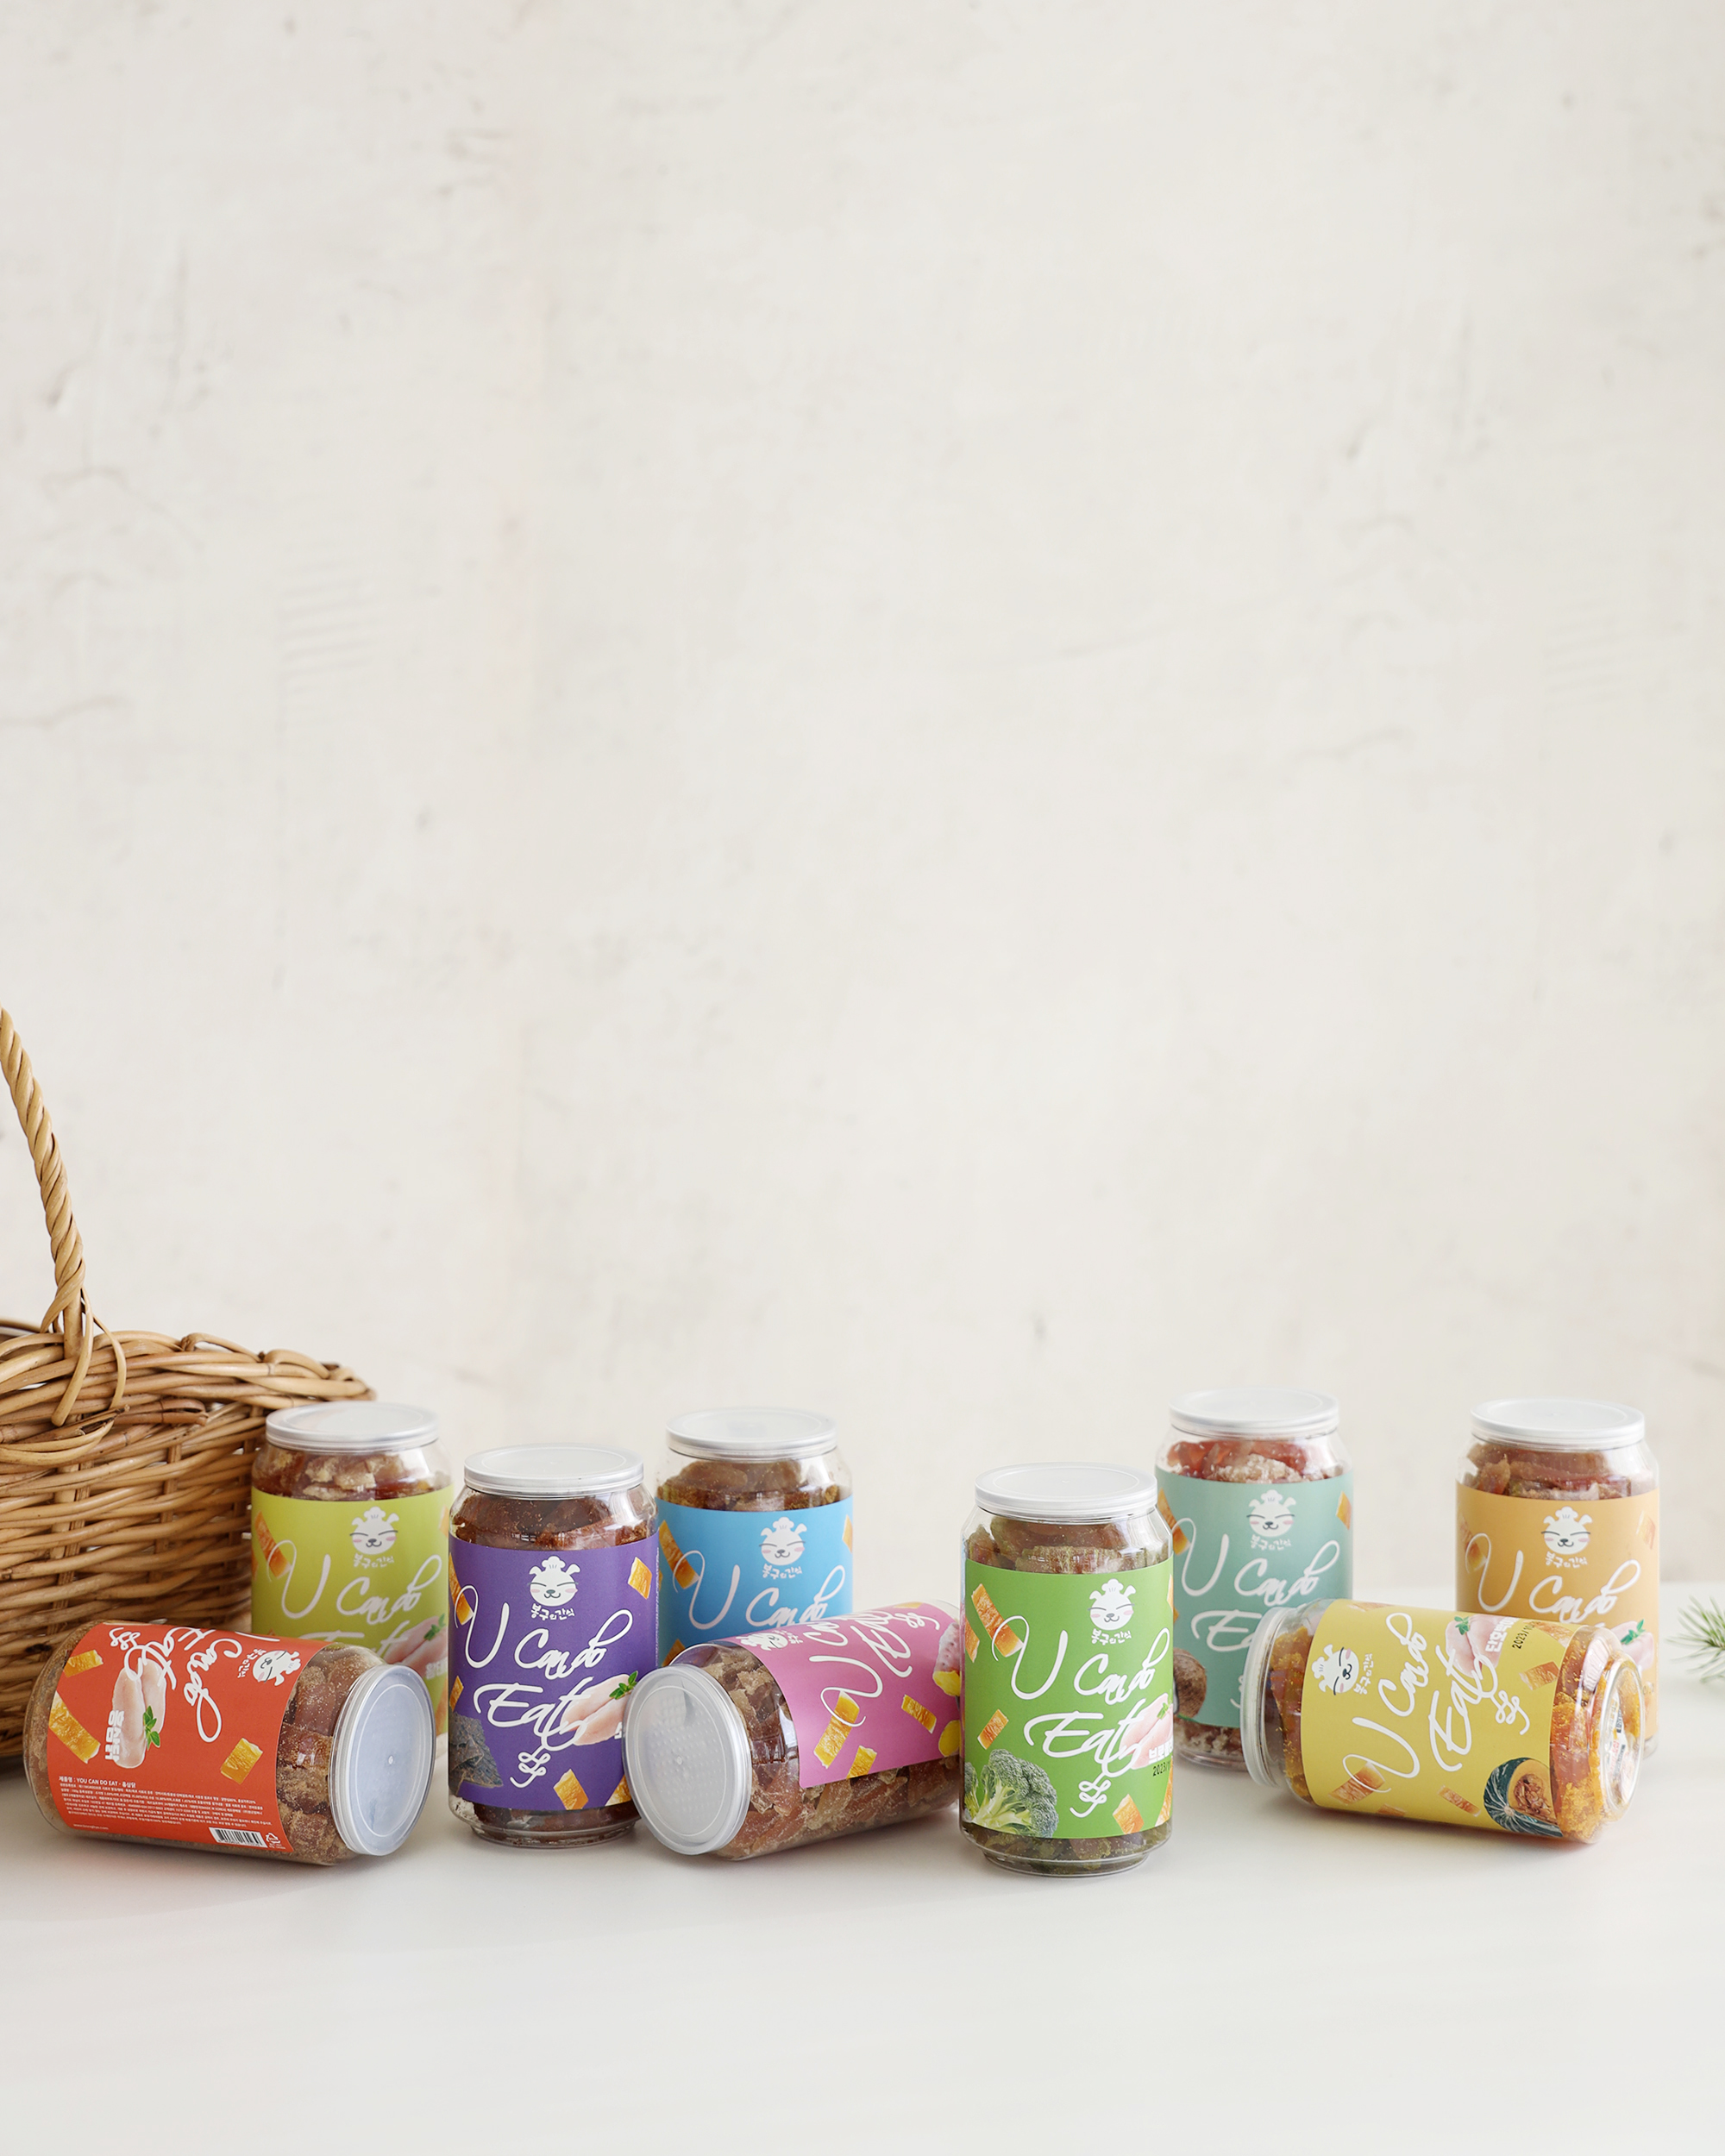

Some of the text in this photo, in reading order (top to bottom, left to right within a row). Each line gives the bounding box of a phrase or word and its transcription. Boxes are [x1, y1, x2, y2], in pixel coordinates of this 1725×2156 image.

[267, 1539, 331, 1619] U
[672, 1550, 741, 1630] U
[1465, 1532, 1524, 1612] U
[454, 1585, 510, 1669] U
[992, 1615, 1069, 1700] U
[1342, 1716, 1421, 1793] U
